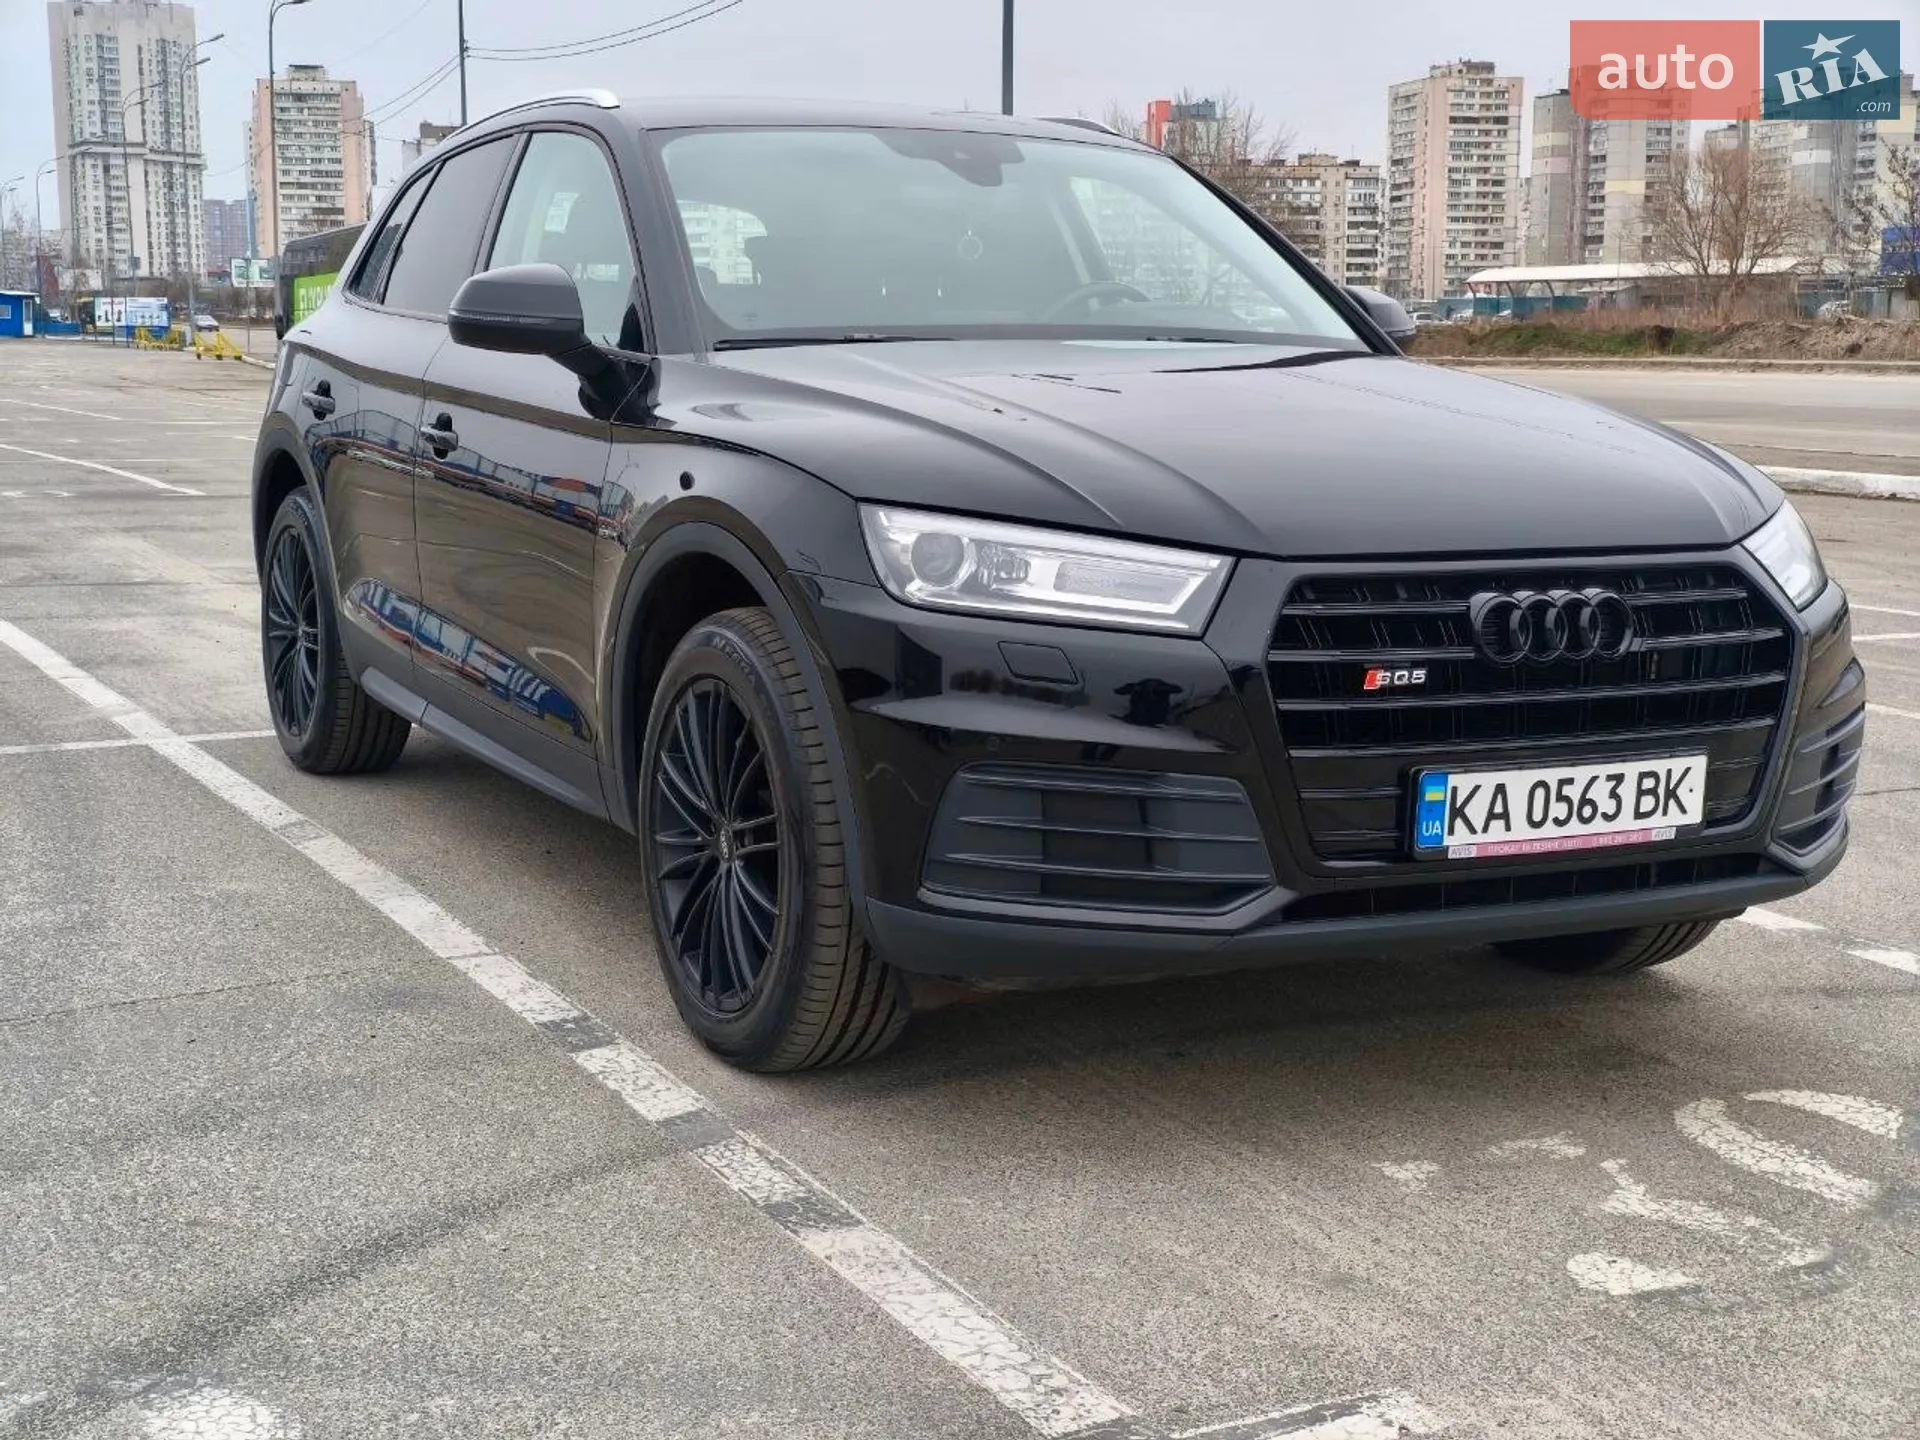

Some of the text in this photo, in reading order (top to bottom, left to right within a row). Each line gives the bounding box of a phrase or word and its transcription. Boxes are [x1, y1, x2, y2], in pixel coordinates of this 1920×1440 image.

[1370, 670, 1427, 687] SQ5
[1448, 766, 1692, 836] KA 0563 BK
[1422, 821, 1442, 836] UA
[1450, 846, 1473, 857] AVIS
